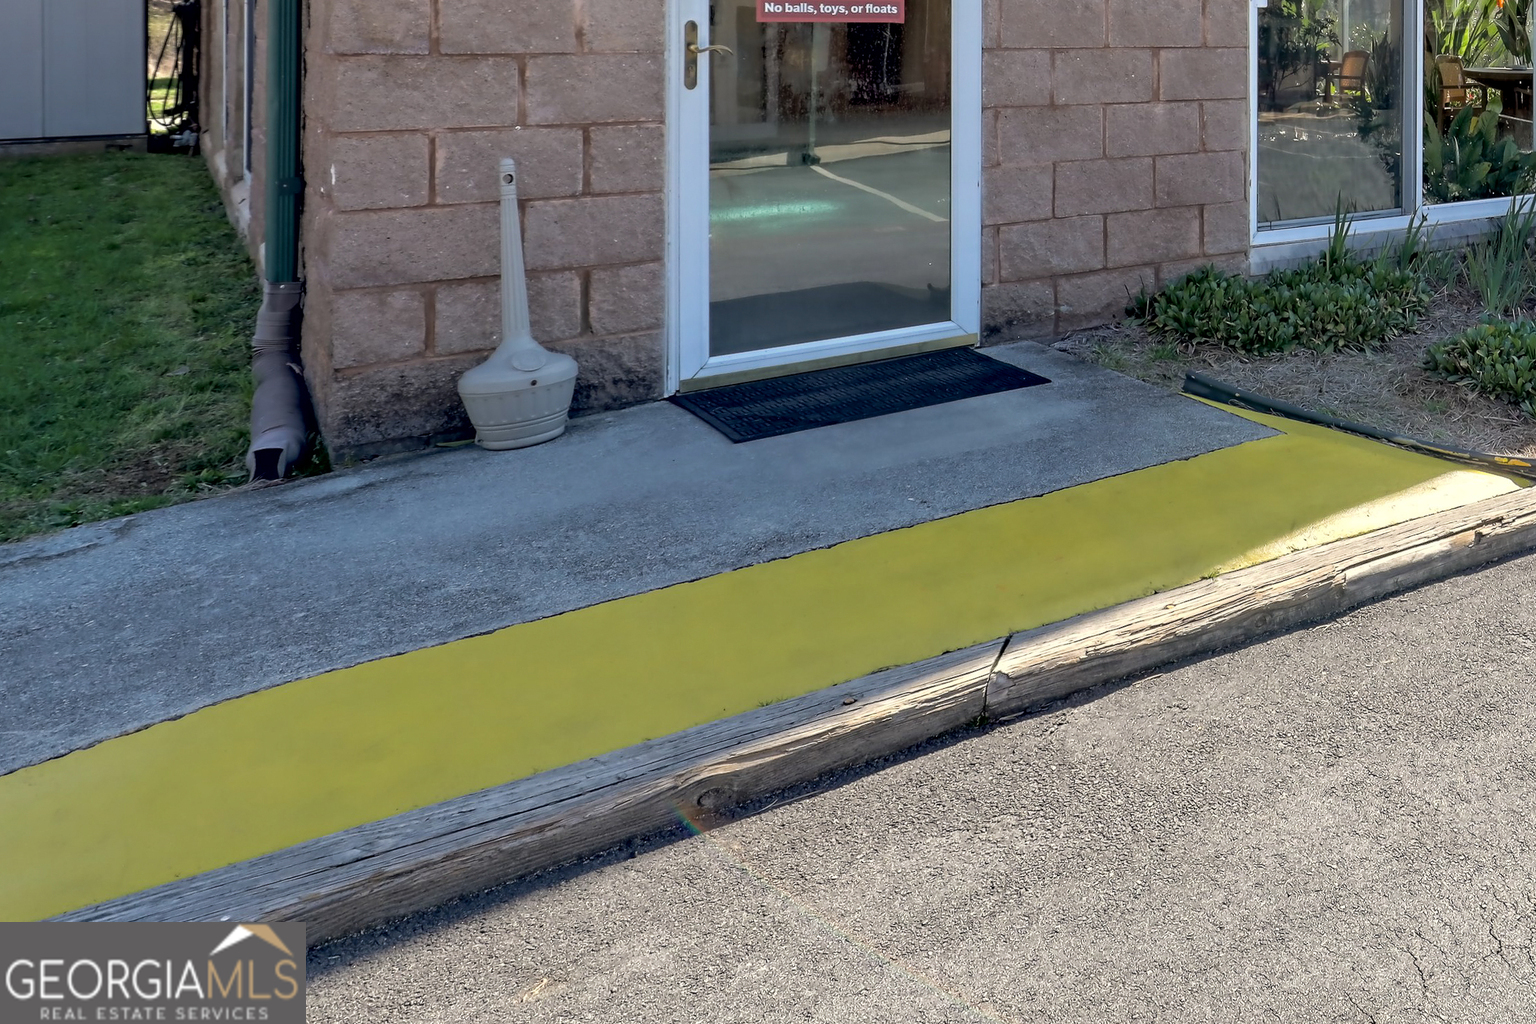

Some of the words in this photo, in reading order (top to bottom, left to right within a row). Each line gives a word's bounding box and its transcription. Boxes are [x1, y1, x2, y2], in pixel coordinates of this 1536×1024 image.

[764, 2, 783, 13] No
[785, 2, 817, 15] balls,
[820, 3, 849, 15] toys,
[851, 5, 863, 14] or
[865, 4, 898, 14] floats
